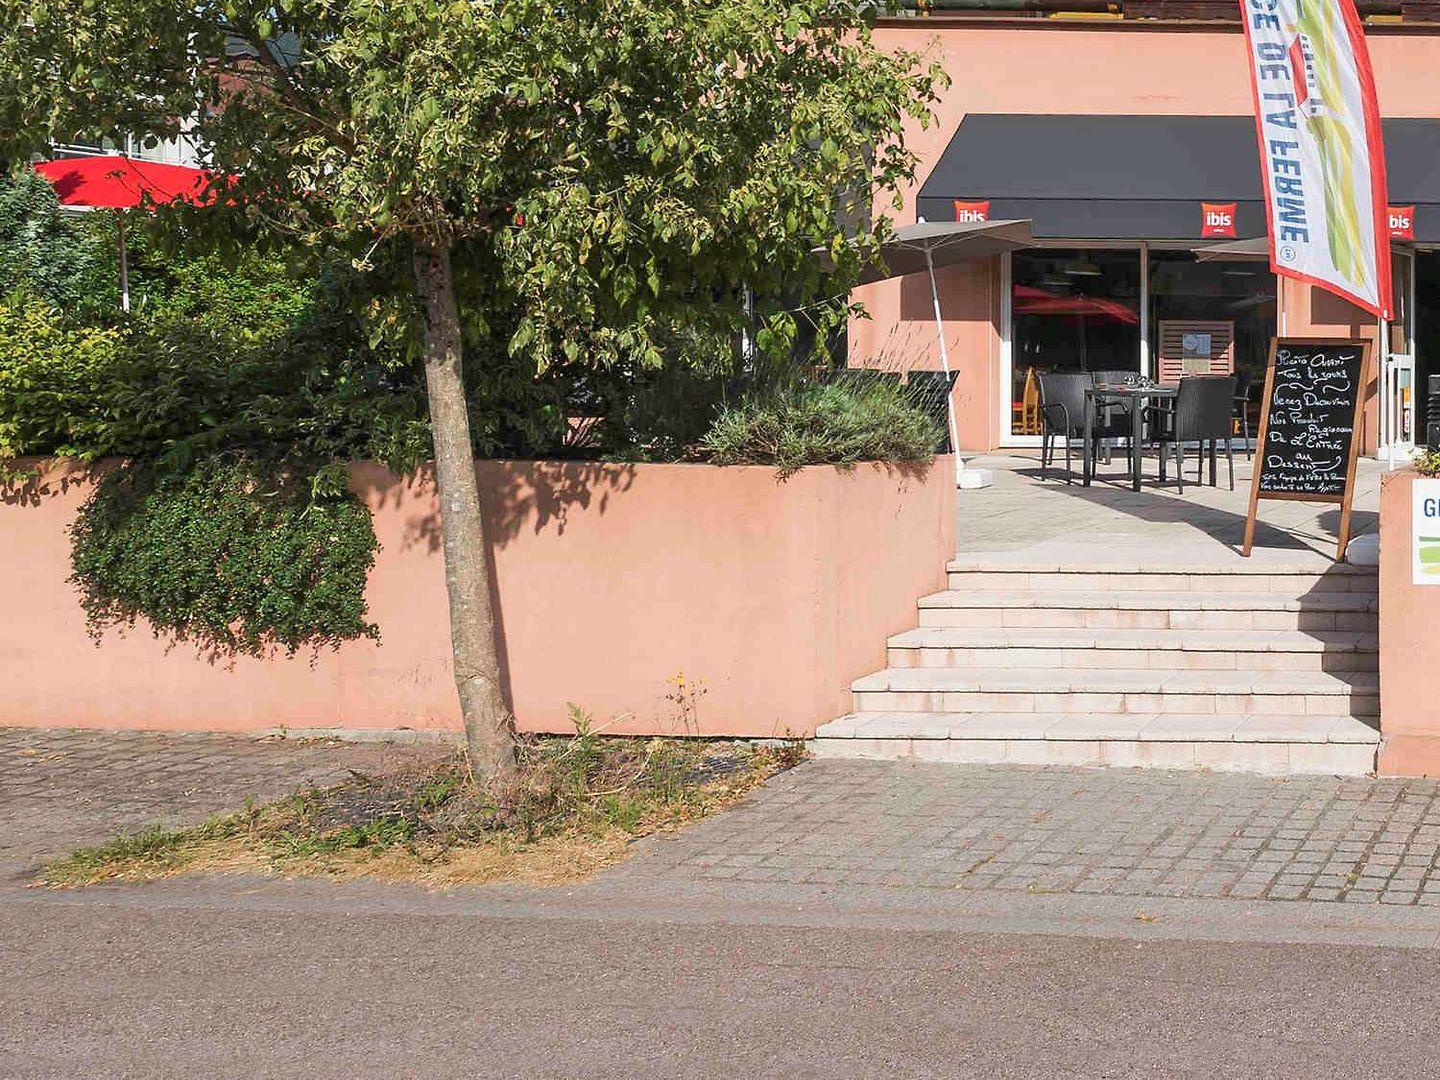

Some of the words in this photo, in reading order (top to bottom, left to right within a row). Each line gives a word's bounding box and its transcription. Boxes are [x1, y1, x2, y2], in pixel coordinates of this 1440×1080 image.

[959, 209, 986, 223] ibis
[1206, 211, 1232, 227] ibis
[1389, 214, 1410, 229] bis
